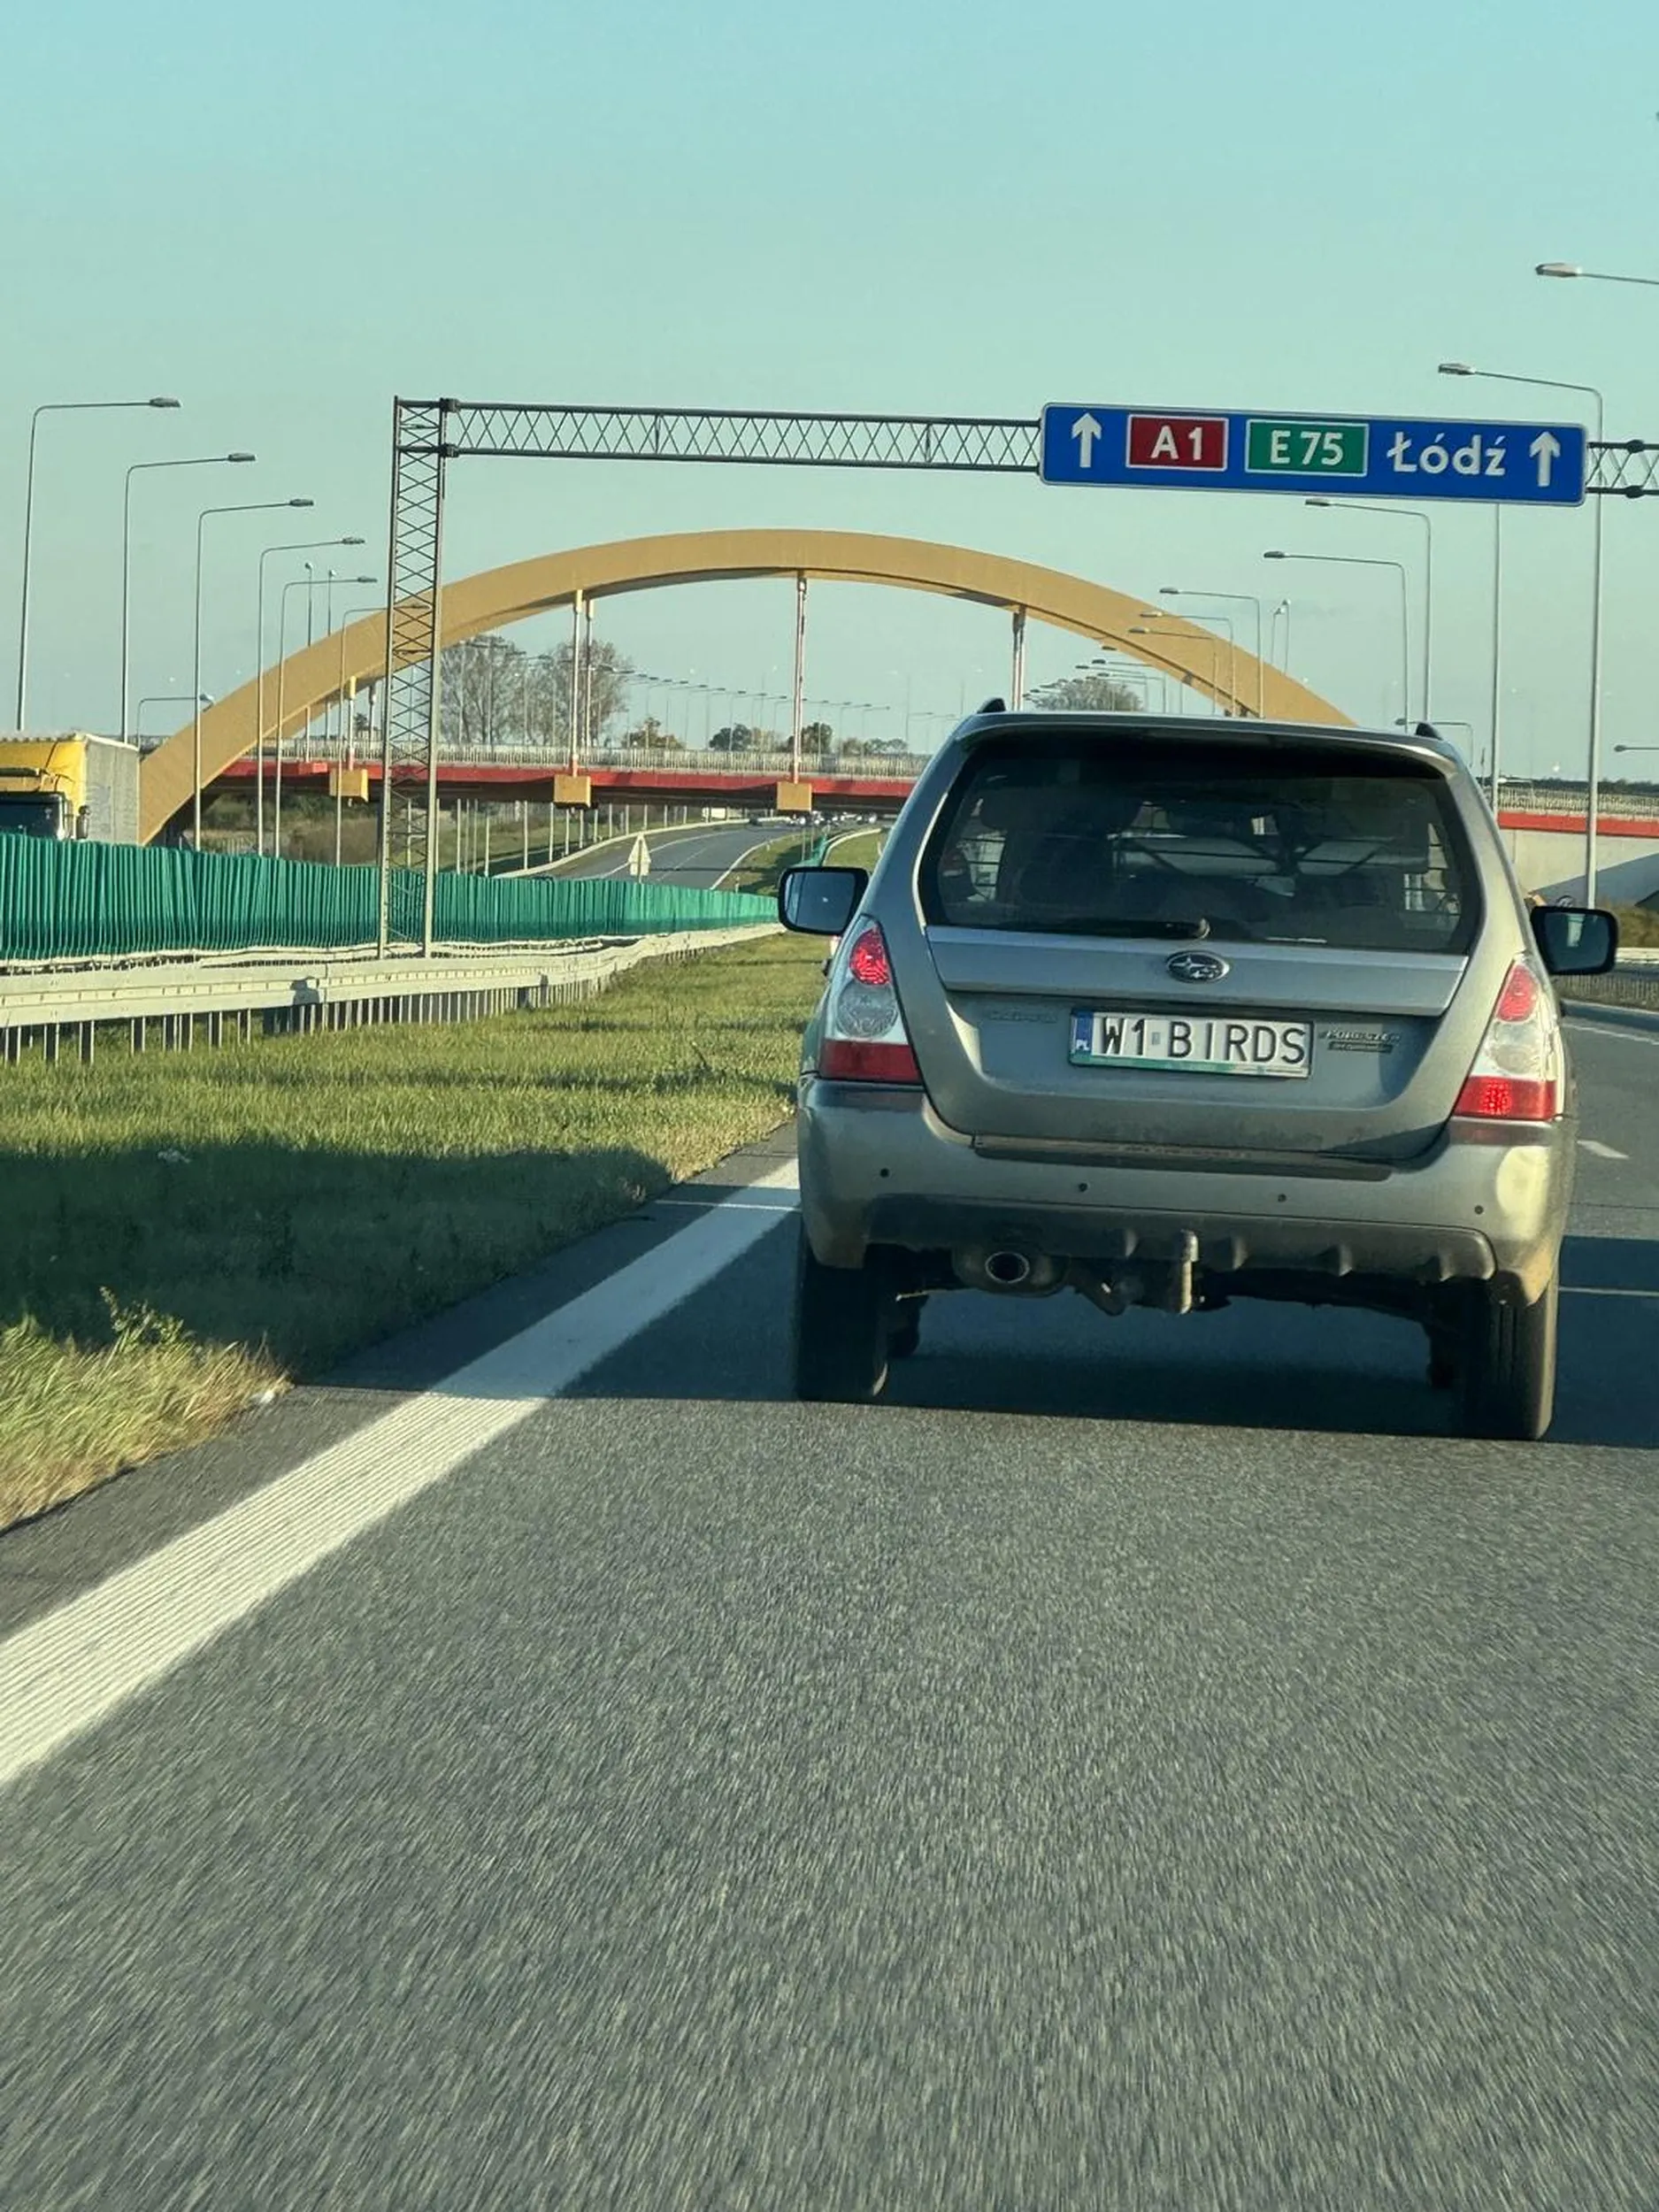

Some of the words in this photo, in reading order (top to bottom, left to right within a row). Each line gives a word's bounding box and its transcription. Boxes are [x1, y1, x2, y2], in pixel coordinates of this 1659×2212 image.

[1150, 425, 1202, 461] A1
[1386, 431, 1506, 476] Łódź
[1102, 1016, 1146, 1056] W1
[1167, 1020, 1307, 1065] BIRDS
